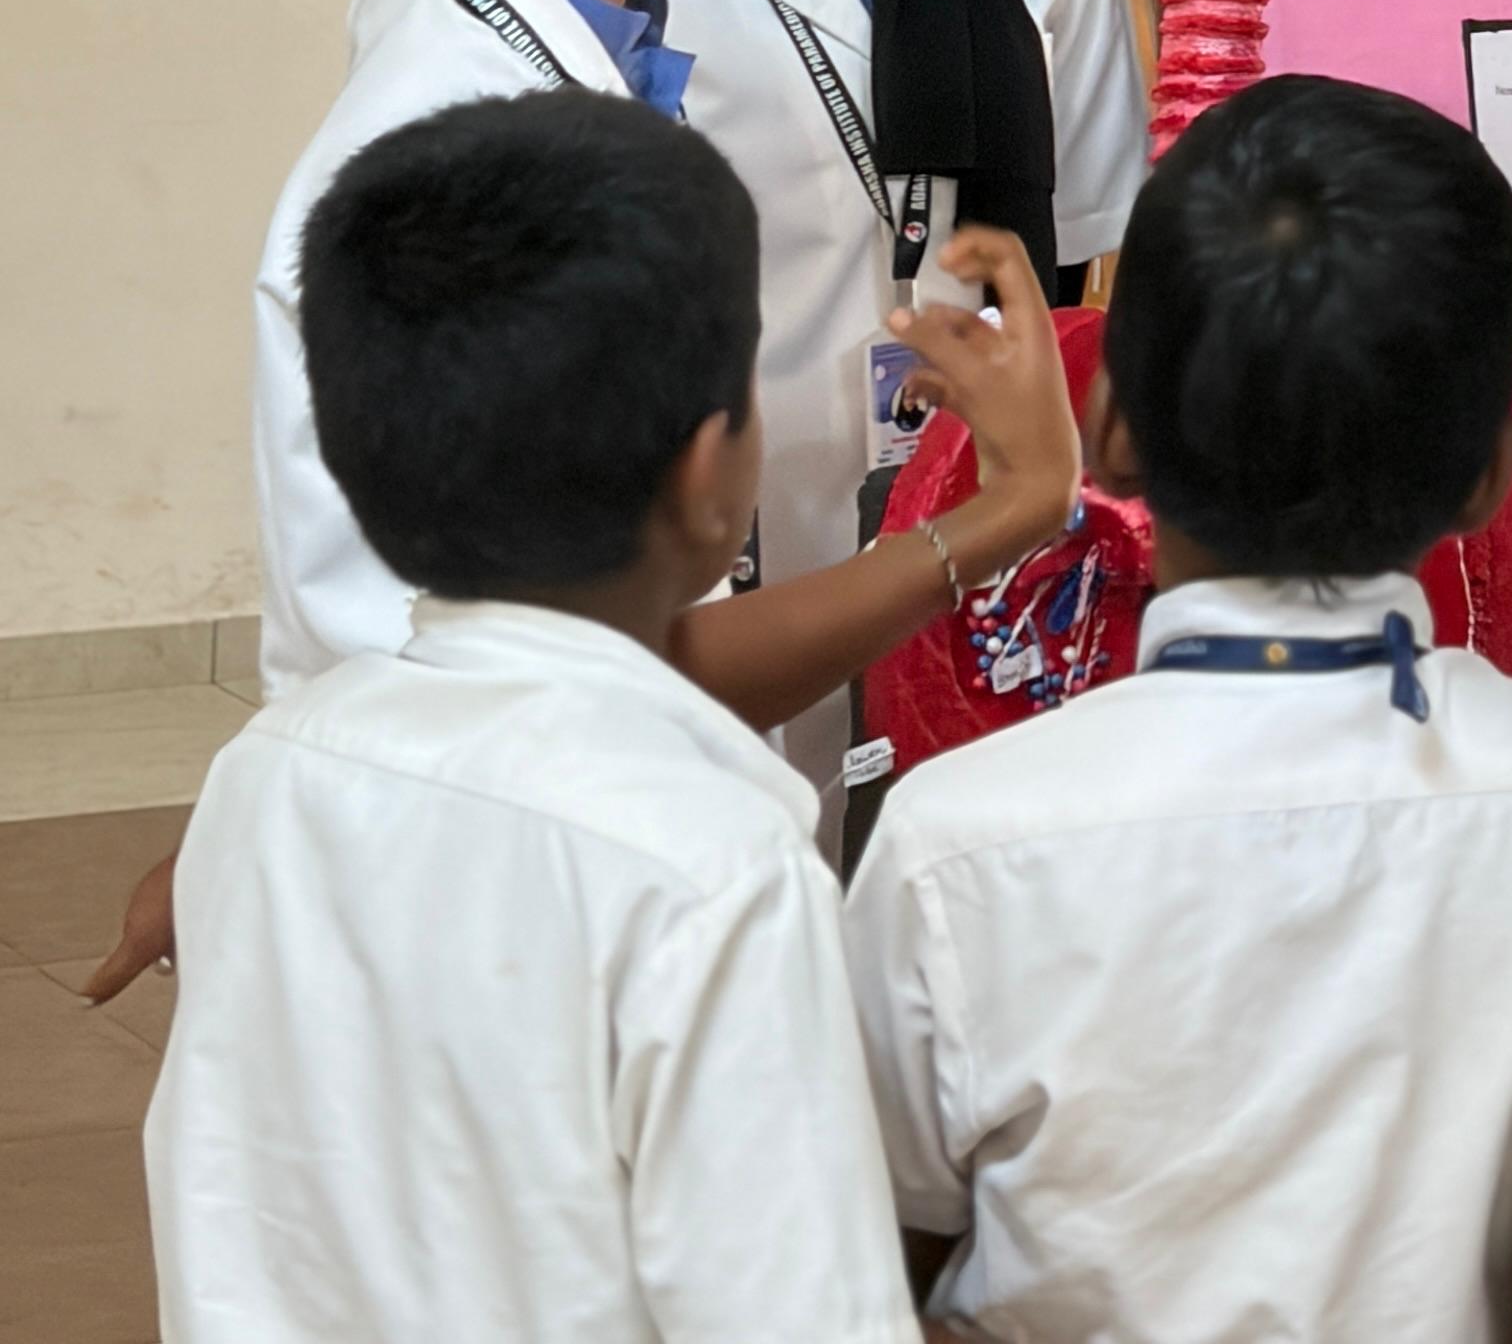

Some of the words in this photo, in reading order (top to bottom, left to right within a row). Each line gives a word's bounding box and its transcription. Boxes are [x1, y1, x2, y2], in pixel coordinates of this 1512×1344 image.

[485, 5, 510, 28] OF
[816, 71, 836, 91] OF
[824, 87, 868, 156] INSTITUTE
